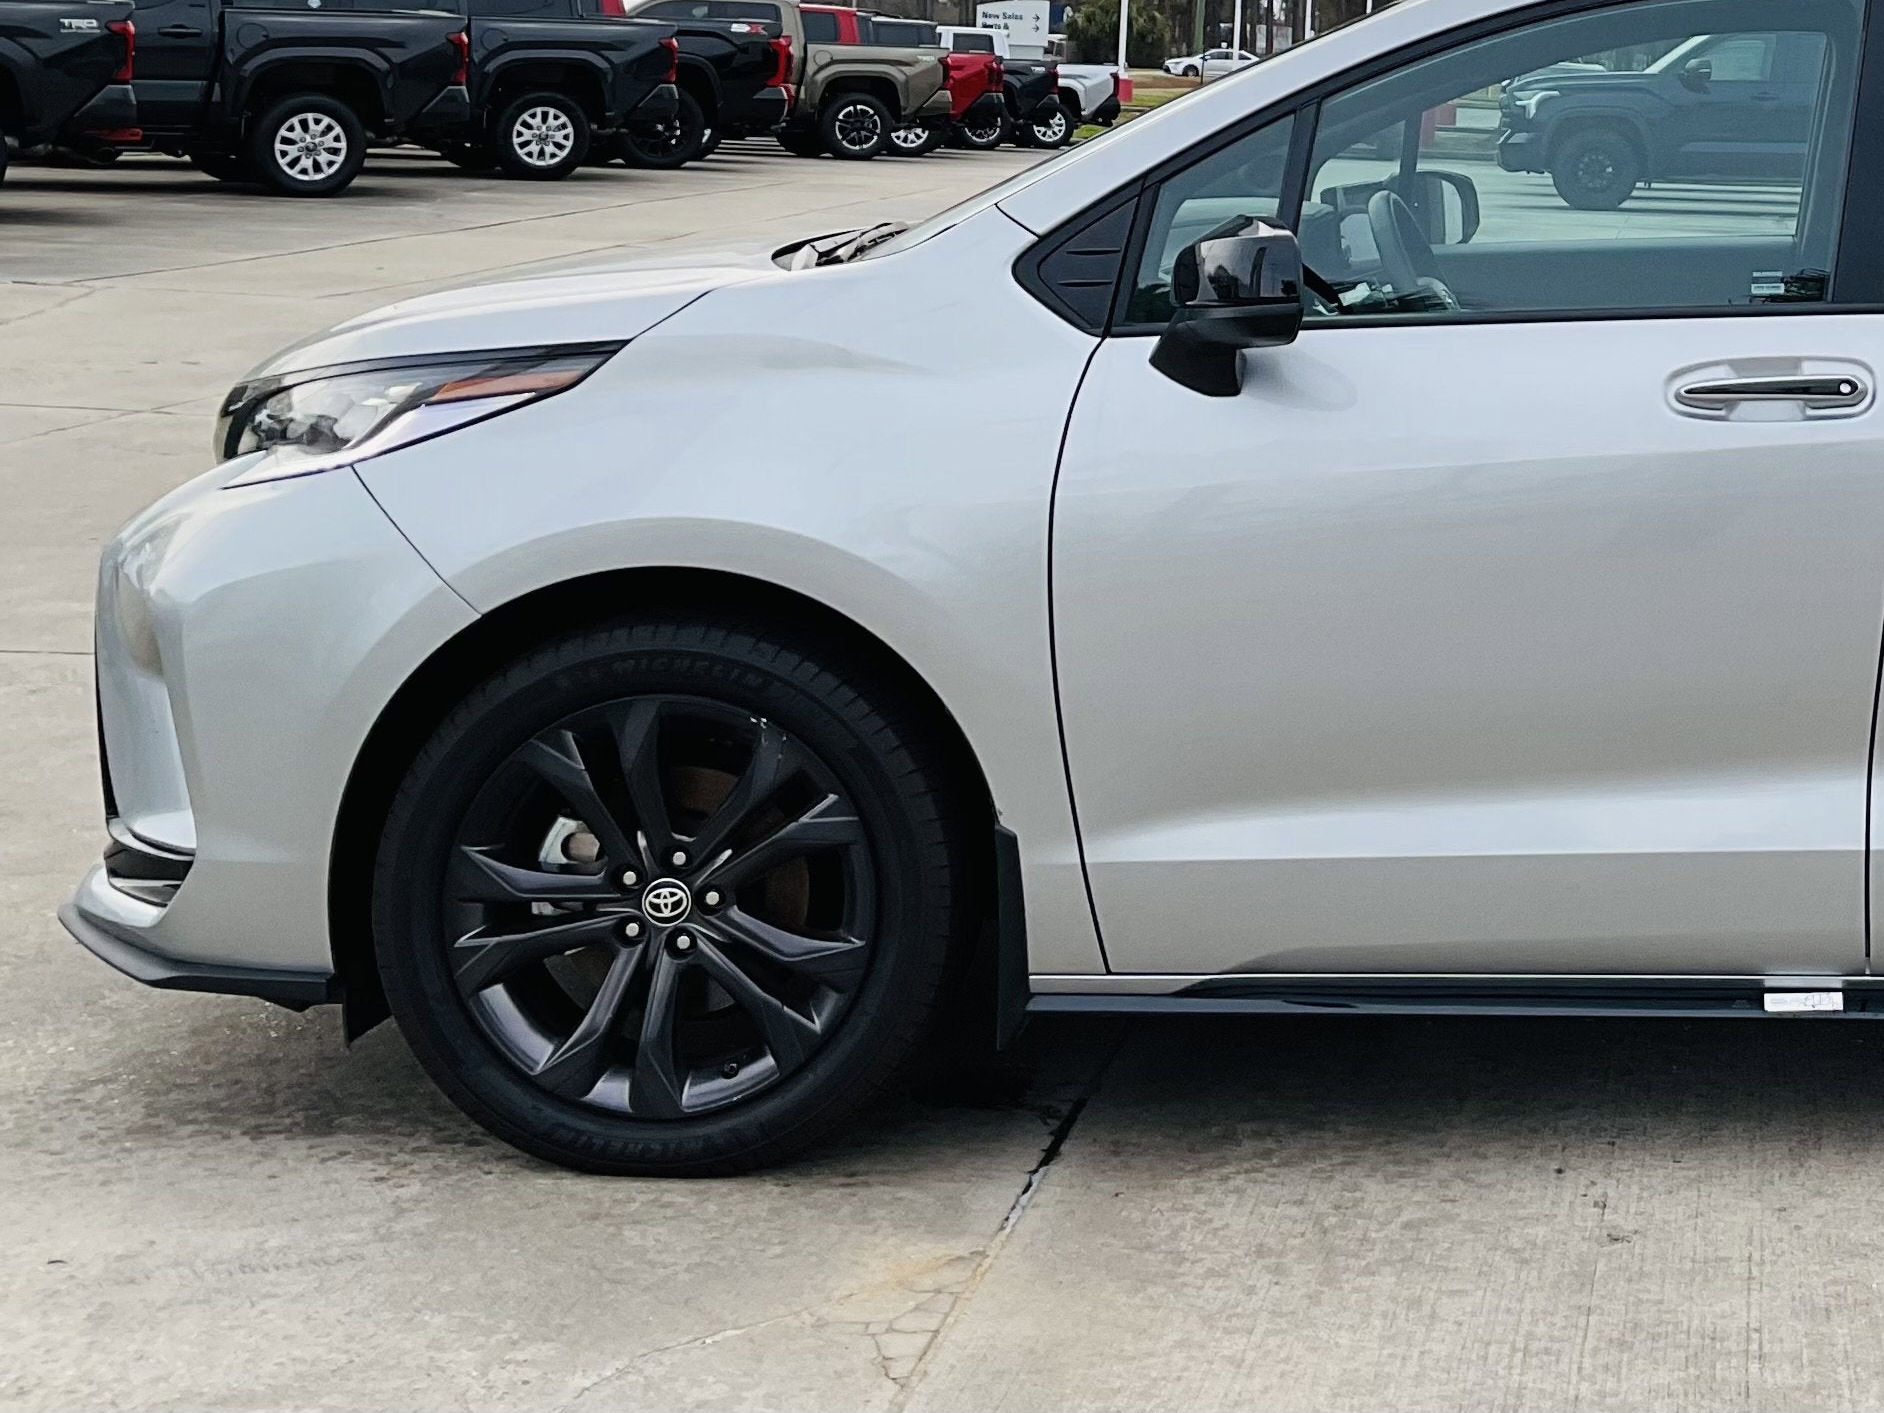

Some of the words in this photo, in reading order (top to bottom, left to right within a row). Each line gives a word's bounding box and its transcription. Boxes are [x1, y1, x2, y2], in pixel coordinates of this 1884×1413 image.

[981, 11, 1000, 19] New
[1002, 11, 1024, 20] Sales
[59, 18, 98, 29] TRD
